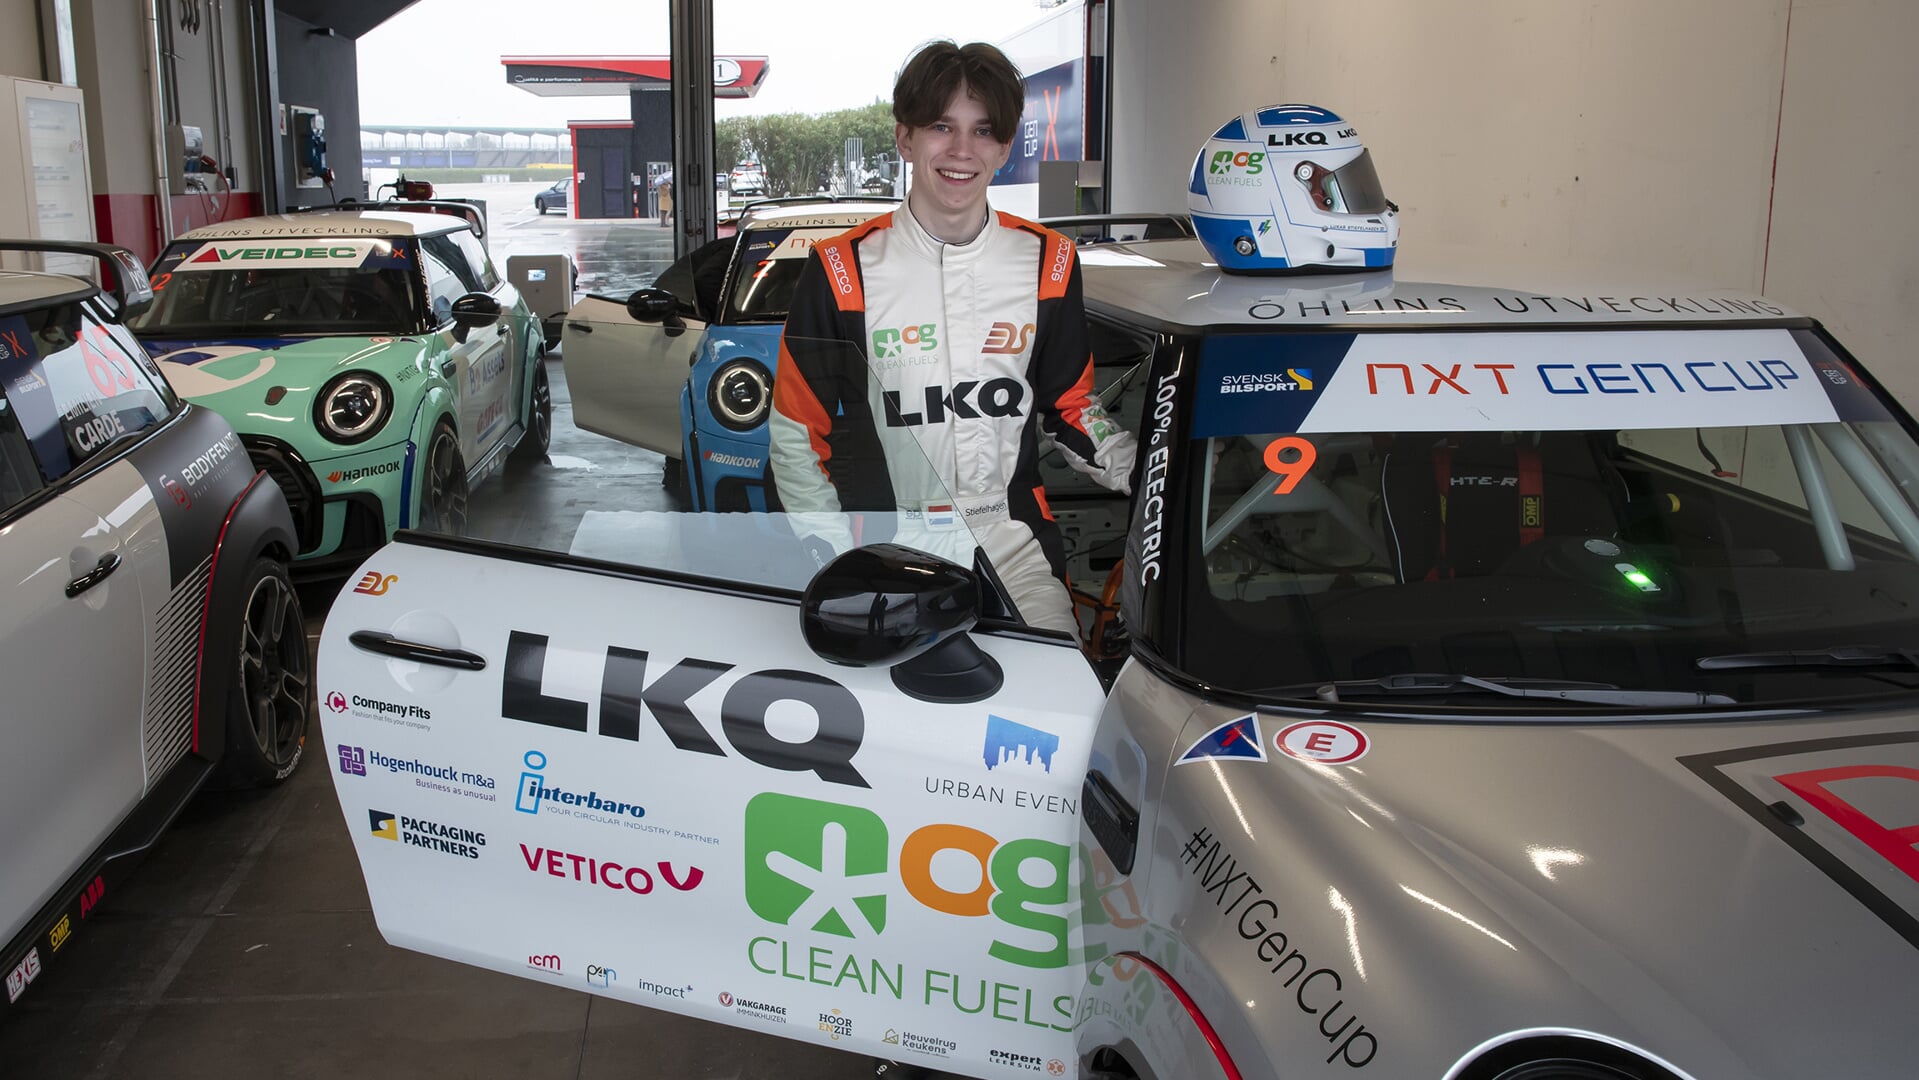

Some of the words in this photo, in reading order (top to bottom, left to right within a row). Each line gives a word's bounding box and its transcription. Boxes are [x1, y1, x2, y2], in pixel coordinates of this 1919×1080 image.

[1268, 131, 1328, 146] LKQ
[1207, 176, 1231, 185] CLEAN
[1234, 178, 1262, 187] FUELS
[262, 227, 389, 235] UTVECKLING
[219, 246, 356, 260] VEIDEC
[1051, 238, 1068, 281] sparco
[827, 246, 853, 294] sparco
[1494, 296, 1785, 316] UTVECKLING
[876, 359, 906, 371] CLEAN
[908, 355, 938, 367] FUELS
[1220, 382, 1297, 394] BILSPORT
[1222, 373, 1284, 385] SVENSK
[883, 377, 1025, 427] LKQ
[1151, 370, 1180, 445] 100%
[75, 409, 126, 452] CARDE
[1263, 436, 1318, 495] 9
[1450, 476, 1519, 487] HTE-R
[965, 501, 1007, 517] Stiefelhagen
[1140, 446, 1168, 587] ELECTRIC
[1525, 496, 1538, 526] OMP
[352, 695, 407, 718] Company
[409, 705, 431, 720] Fits
[352, 710, 372, 719] Fashion
[373, 713, 384, 721] that
[393, 719, 405, 727] your
[406, 721, 431, 732] company
[502, 629, 873, 789] LKQ
[370, 750, 458, 782] Hogenhouck
[462, 772, 495, 789] m&a
[415, 778, 451, 793] Business
[452, 786, 462, 795] as
[464, 790, 496, 802] unusual
[528, 780, 646, 819] interbaro
[925, 776, 1004, 804] URBAN
[401, 815, 486, 846] PACKAGING
[545, 805, 571, 817] YOUR
[574, 811, 620, 826] CIRCULAR
[624, 821, 671, 836] INDUSTRY
[674, 830, 720, 846] PARTNER
[403, 831, 480, 860] PARTNERS
[518, 843, 654, 895] VETICO
[81, 876, 105, 919] ABB
[50, 917, 70, 949] OMP
[1180, 827, 1378, 1069] #NXTGenCup
[6, 952, 41, 999] HEXIS
[747, 936, 903, 1000] CLEAN
[924, 969, 1073, 1033] FUELS
[736, 998, 787, 1016] VAKGARAGE
[736, 1007, 787, 1024] IMMINKHUIZEN
[819, 1013, 852, 1027] HOOR
[902, 1039, 947, 1055] Keukens
[903, 1031, 957, 1051] Heuvelrug
[989, 1048, 1042, 1066] expert
[989, 1057, 1041, 1072] LEERSUM
